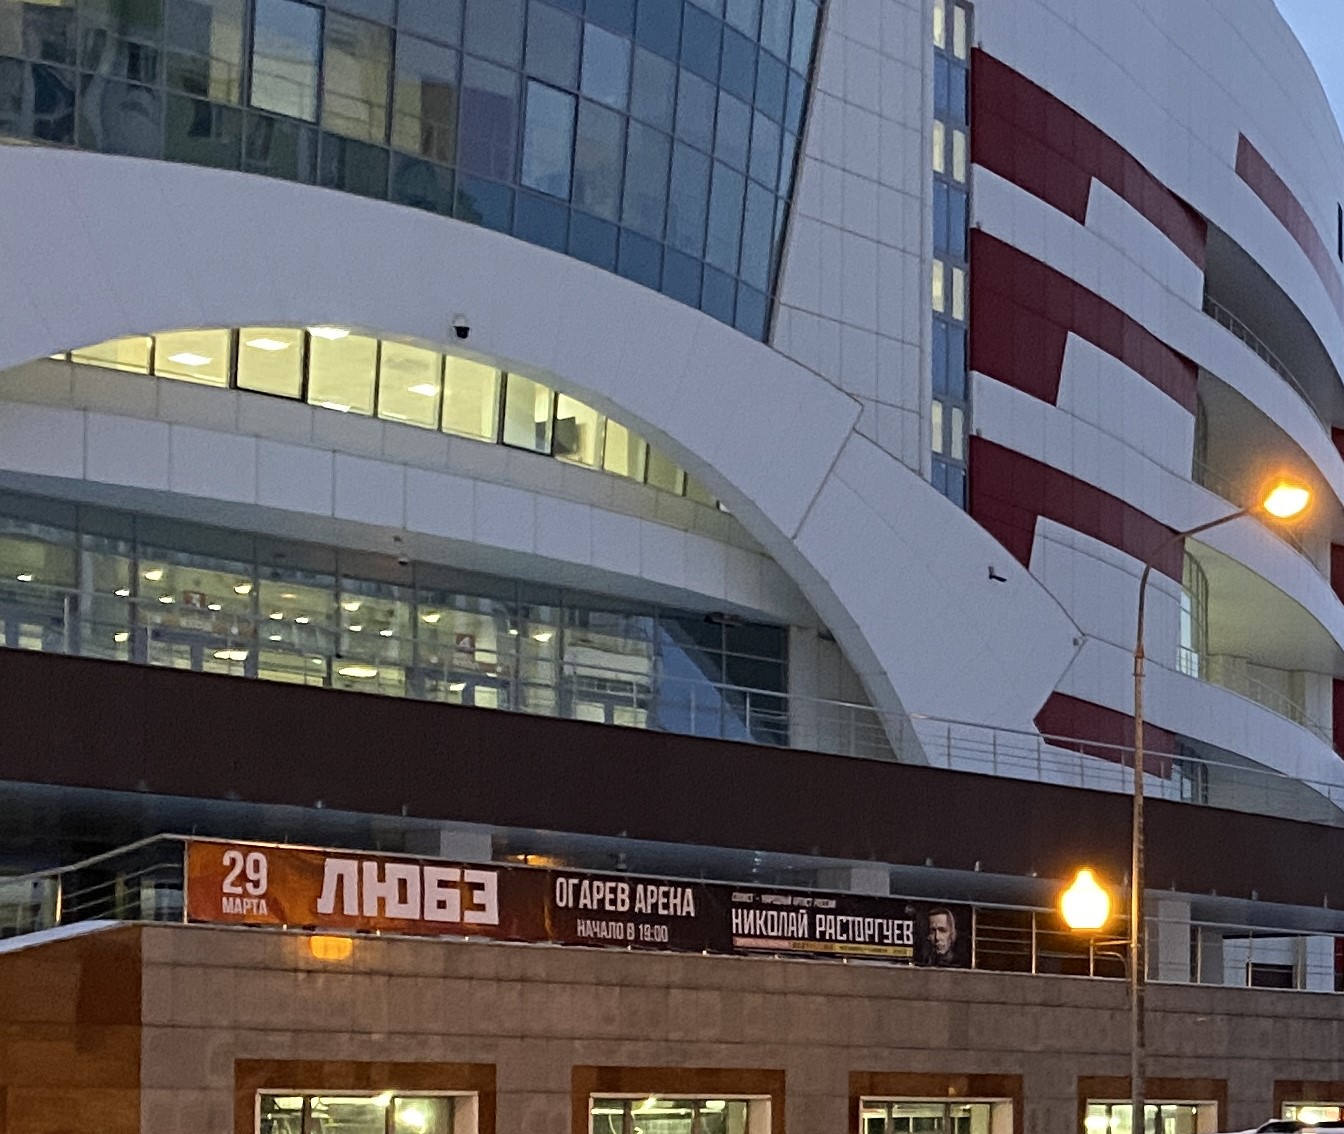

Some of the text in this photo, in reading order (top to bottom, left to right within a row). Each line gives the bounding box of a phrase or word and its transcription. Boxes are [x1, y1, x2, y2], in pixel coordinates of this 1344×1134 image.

[222, 850, 268, 896] 29
[317, 858, 499, 925] ЛЮБЭ
[222, 897, 268, 916] МАРТА
[555, 877, 630, 912] ОГАРЕВ
[634, 884, 696, 917] АРЕНА
[576, 919, 669, 943] НАЧАЛО В 19:00
[731, 908, 914, 945] НИКОЛАЙ РАСТОРГУЕВ
